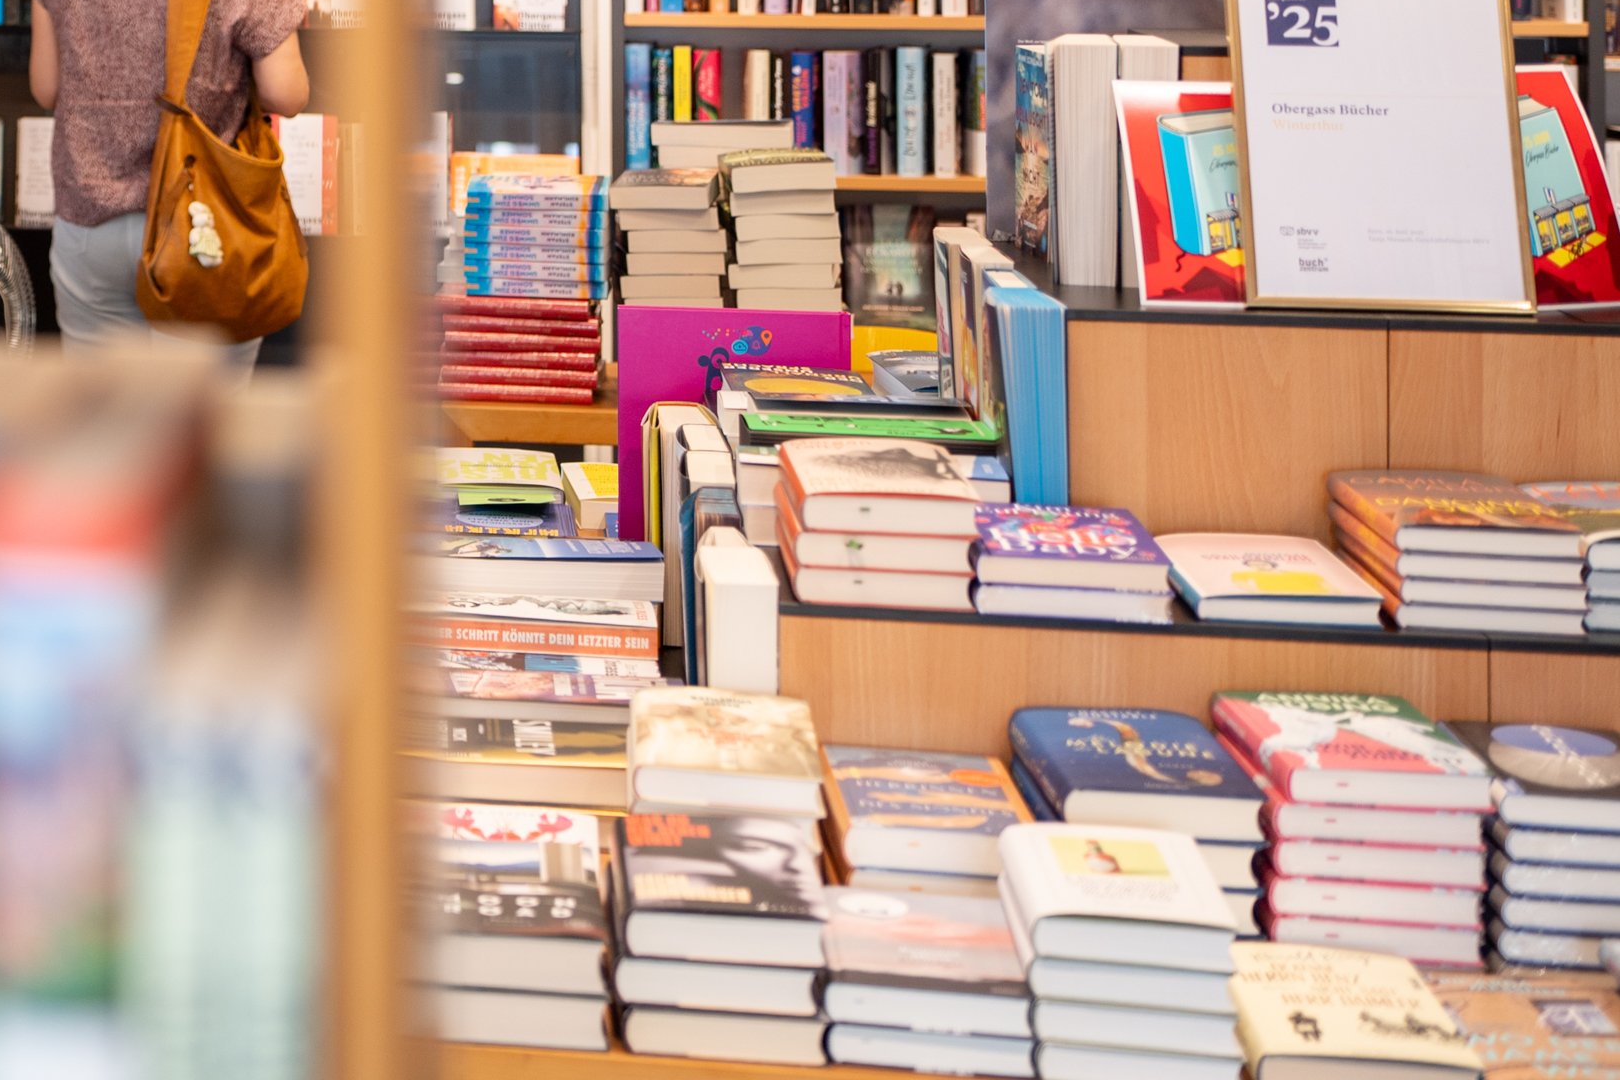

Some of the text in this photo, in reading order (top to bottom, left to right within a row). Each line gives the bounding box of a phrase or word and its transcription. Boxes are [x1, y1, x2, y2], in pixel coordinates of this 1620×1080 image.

[1271, 103, 1390, 117] Obergass Bücher
[1273, 120, 1345, 131] Winterthur
[1298, 257, 1324, 267] buch
[988, 526, 1138, 549] Hello
[993, 539, 1138, 560] Baby
[455, 628, 499, 642] SCHRITT
[502, 627, 546, 644] KÖNNTE
[549, 632, 575, 646] DEIN
[578, 634, 621, 648] LETZTER
[624, 636, 649, 649] SEIN
